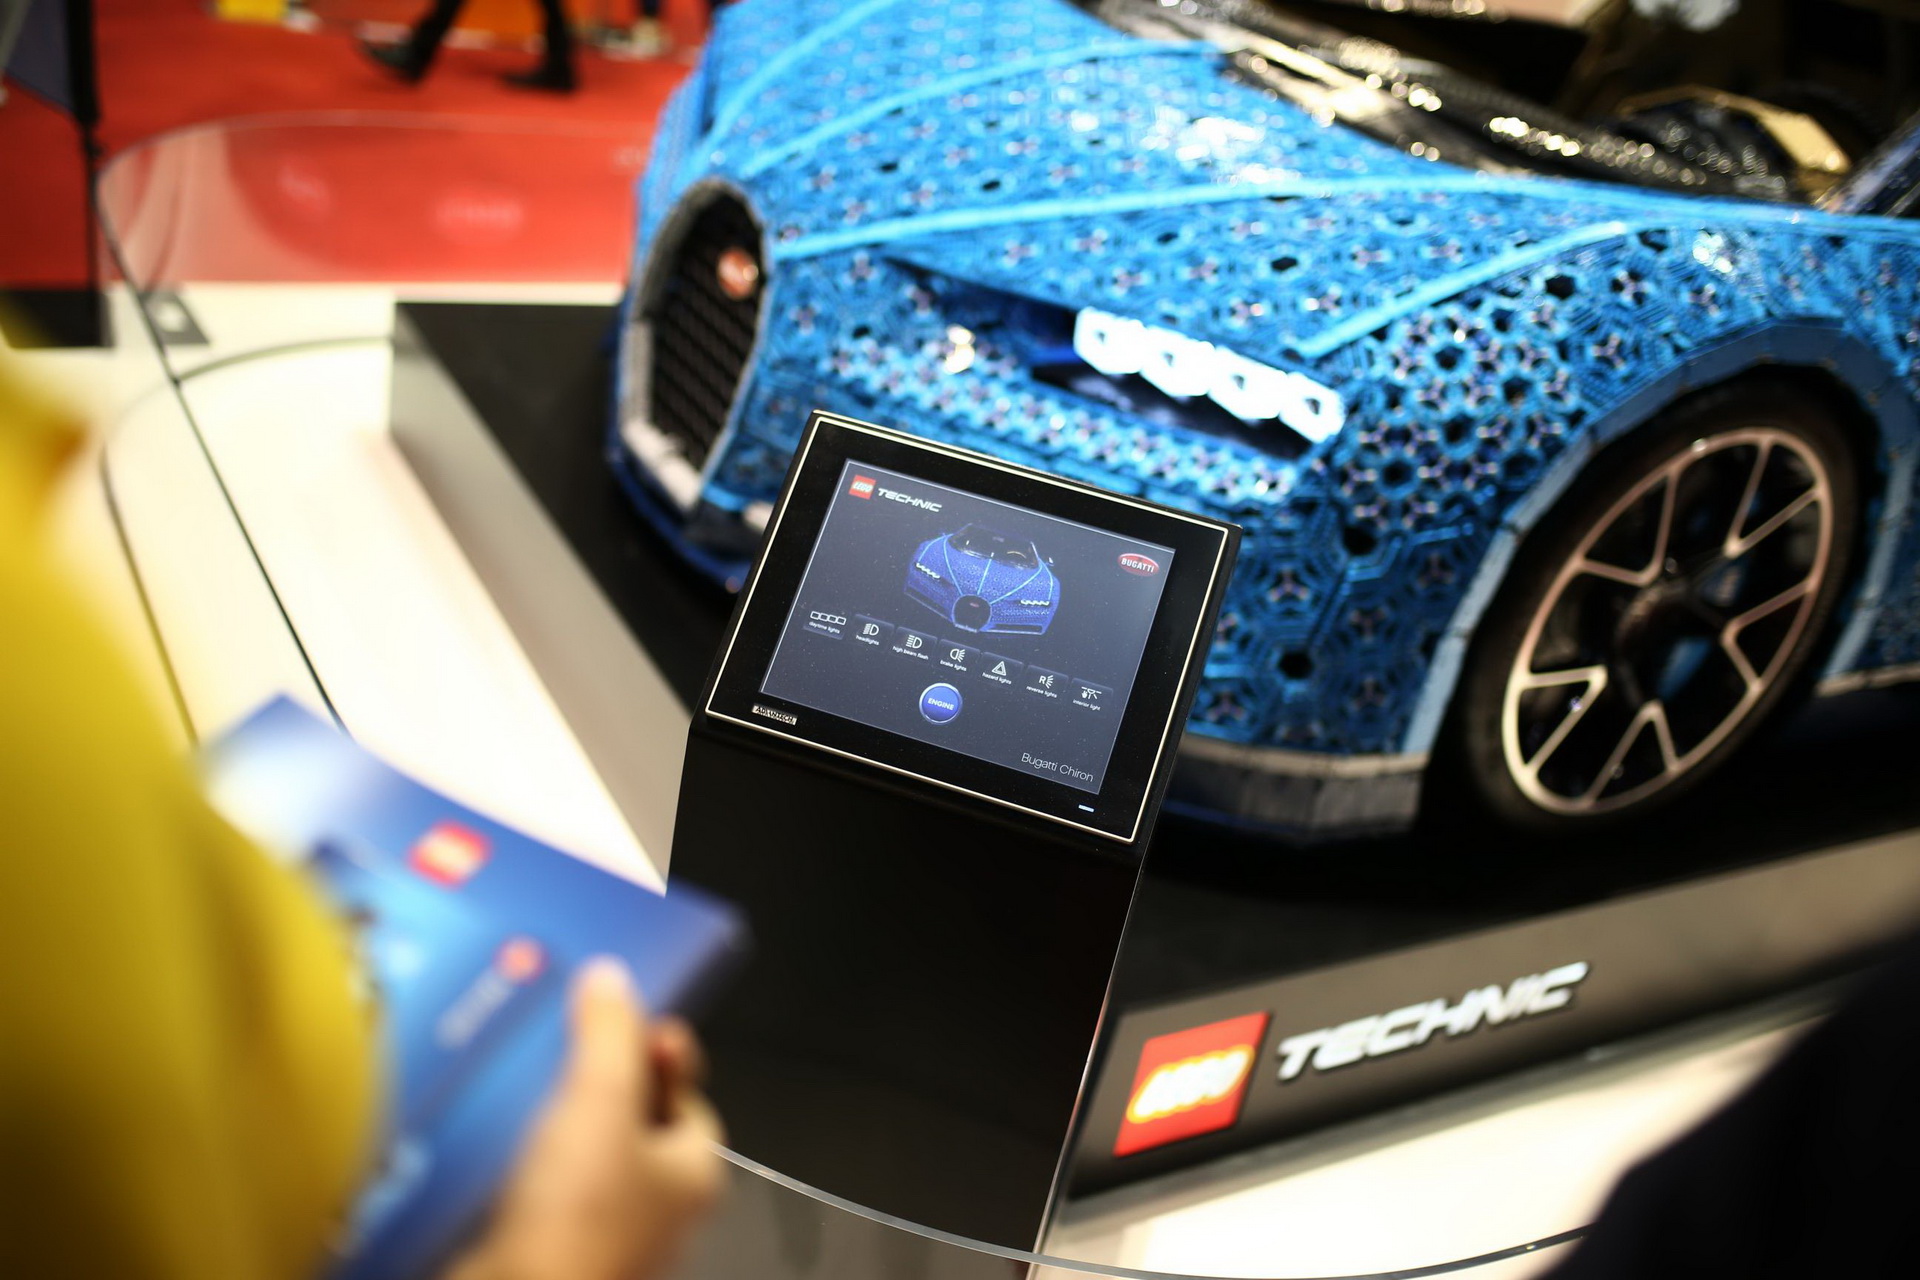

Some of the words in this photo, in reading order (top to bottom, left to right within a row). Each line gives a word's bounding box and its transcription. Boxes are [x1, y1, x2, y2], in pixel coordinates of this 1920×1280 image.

[853, 481, 874, 493] LEGO
[878, 487, 943, 513] TECHNIC
[1121, 557, 1155, 573] BUGATTI
[828, 624, 841, 634] lights
[856, 634, 880, 646] headlights
[892, 645, 903, 653] high
[904, 649, 917, 657] beam
[917, 652, 929, 660] flash
[940, 659, 954, 668] brake
[954, 663, 967, 672] lights
[982, 672, 998, 681] hazard
[998, 676, 1012, 685] lights
[1026, 686, 1044, 694] reverse
[1044, 690, 1058, 698] lights
[927, 697, 955, 711] ENGINE
[1072, 699, 1089, 708] interior
[1089, 703, 1101, 711] light
[1021, 752, 1058, 772] Bugatti
[1059, 764, 1094, 782] Chiron
[1278, 961, 1589, 1080] TECHNIC
